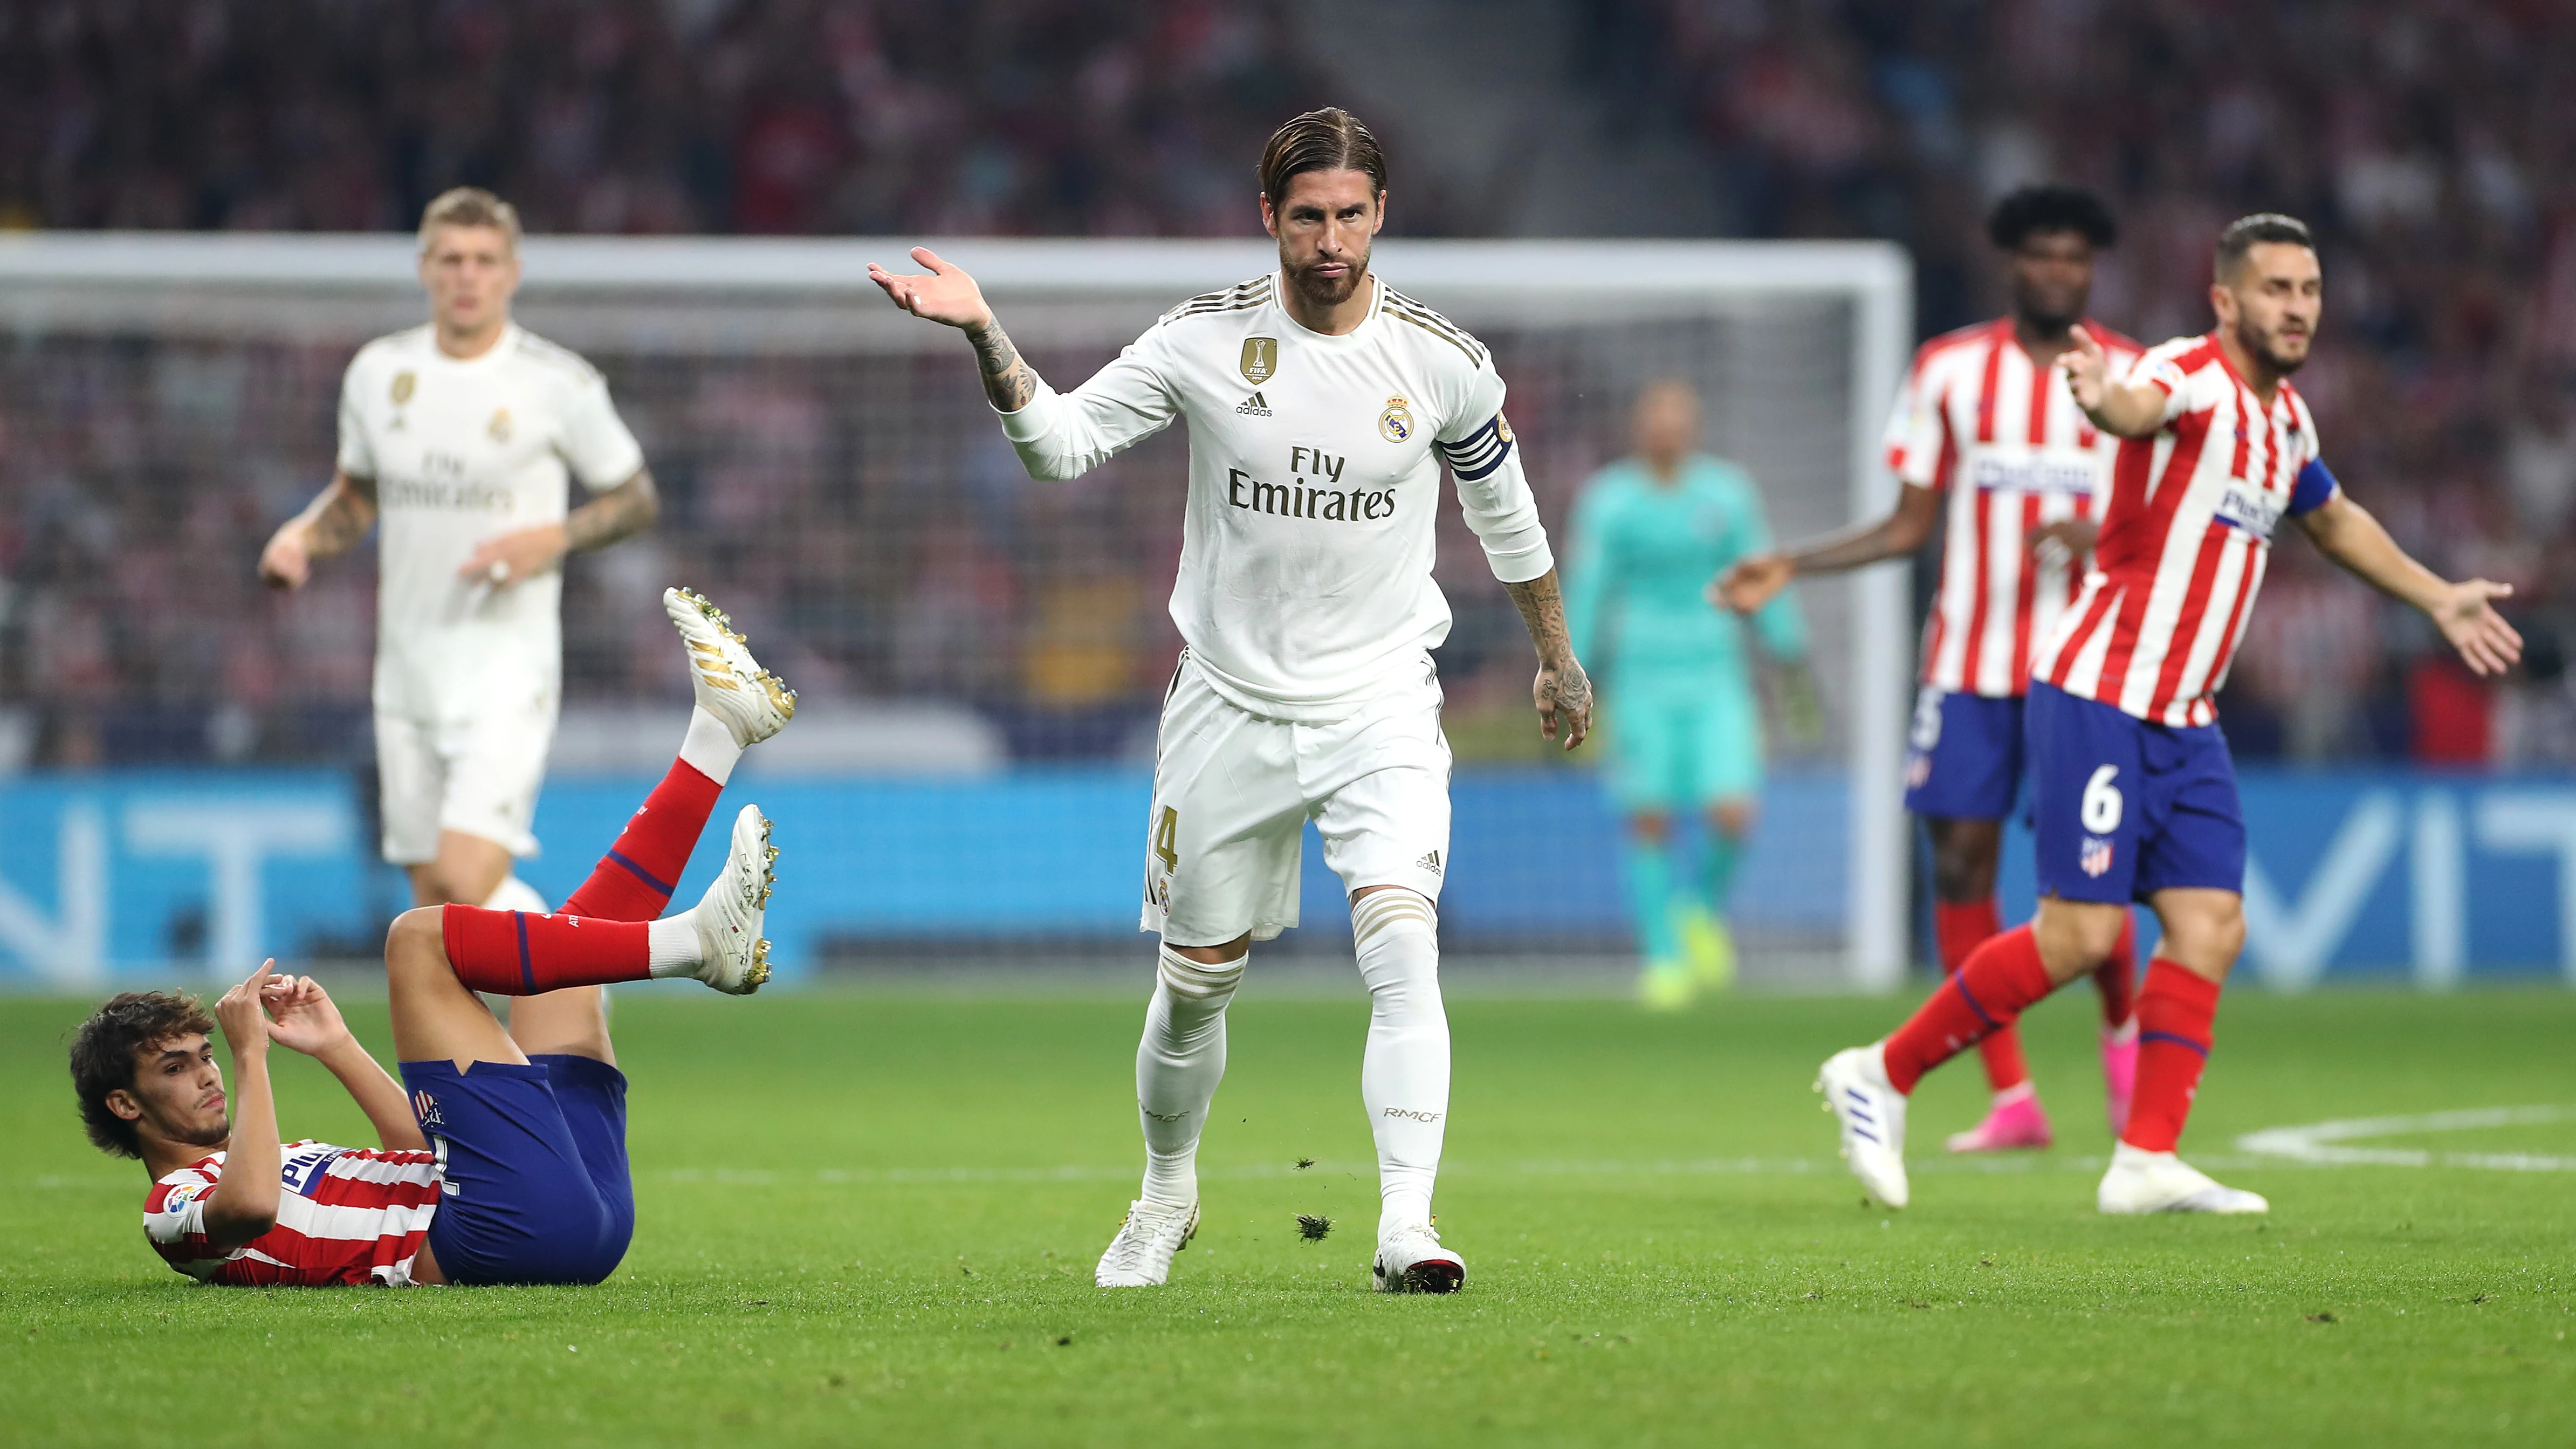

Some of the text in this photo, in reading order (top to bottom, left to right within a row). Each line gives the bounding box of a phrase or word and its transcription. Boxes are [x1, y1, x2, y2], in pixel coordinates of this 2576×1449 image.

[1236, 406, 1273, 417] adidas
[1291, 445, 1345, 483] Fly
[1228, 468, 1396, 521] Emirates
[2080, 763, 2123, 834] 6
[1155, 805, 1178, 877] 4
[1416, 860, 1441, 877] adidas
[1383, 1107, 1442, 1123] RMCF
